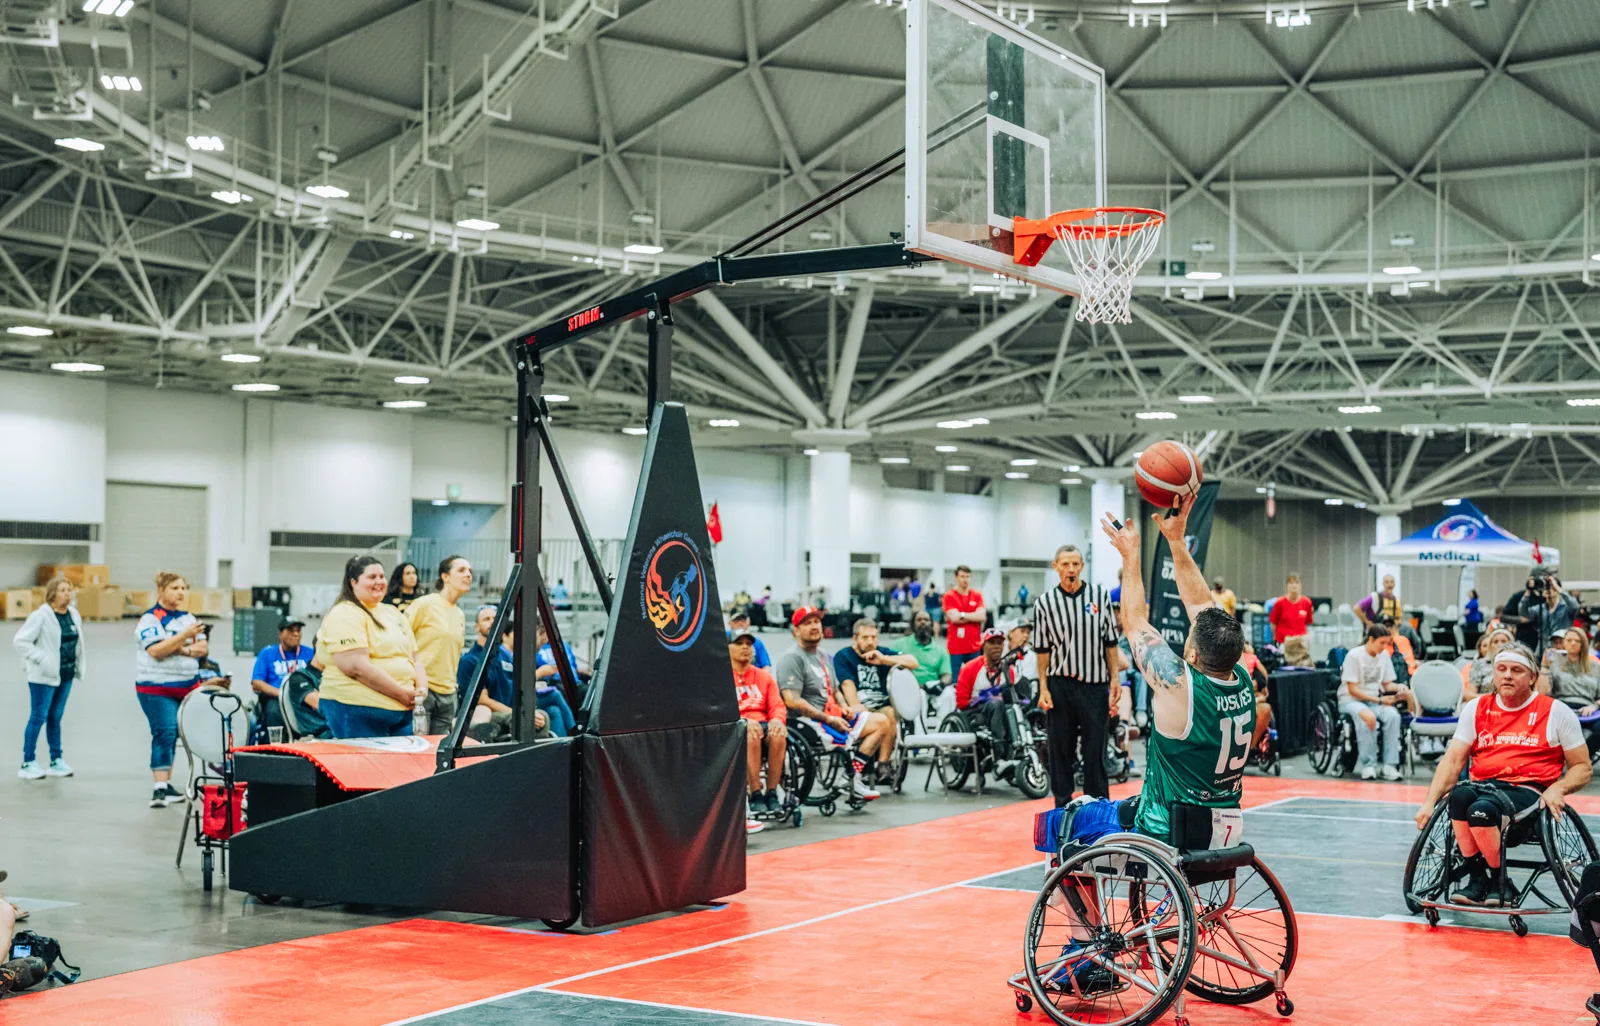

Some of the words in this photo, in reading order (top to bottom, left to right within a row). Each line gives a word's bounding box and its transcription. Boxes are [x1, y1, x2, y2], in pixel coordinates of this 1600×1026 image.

[568, 306, 600, 332] STORM
[655, 530, 683, 546] Wheelchair
[683, 532, 700, 553] Games
[640, 545, 657, 579] Veterans
[1419, 551, 1480, 562] Medical
[640, 582, 648, 620] National
[1528, 712, 1538, 725] 11
[1215, 710, 1252, 774] 15
[1224, 825, 1232, 847] 7
